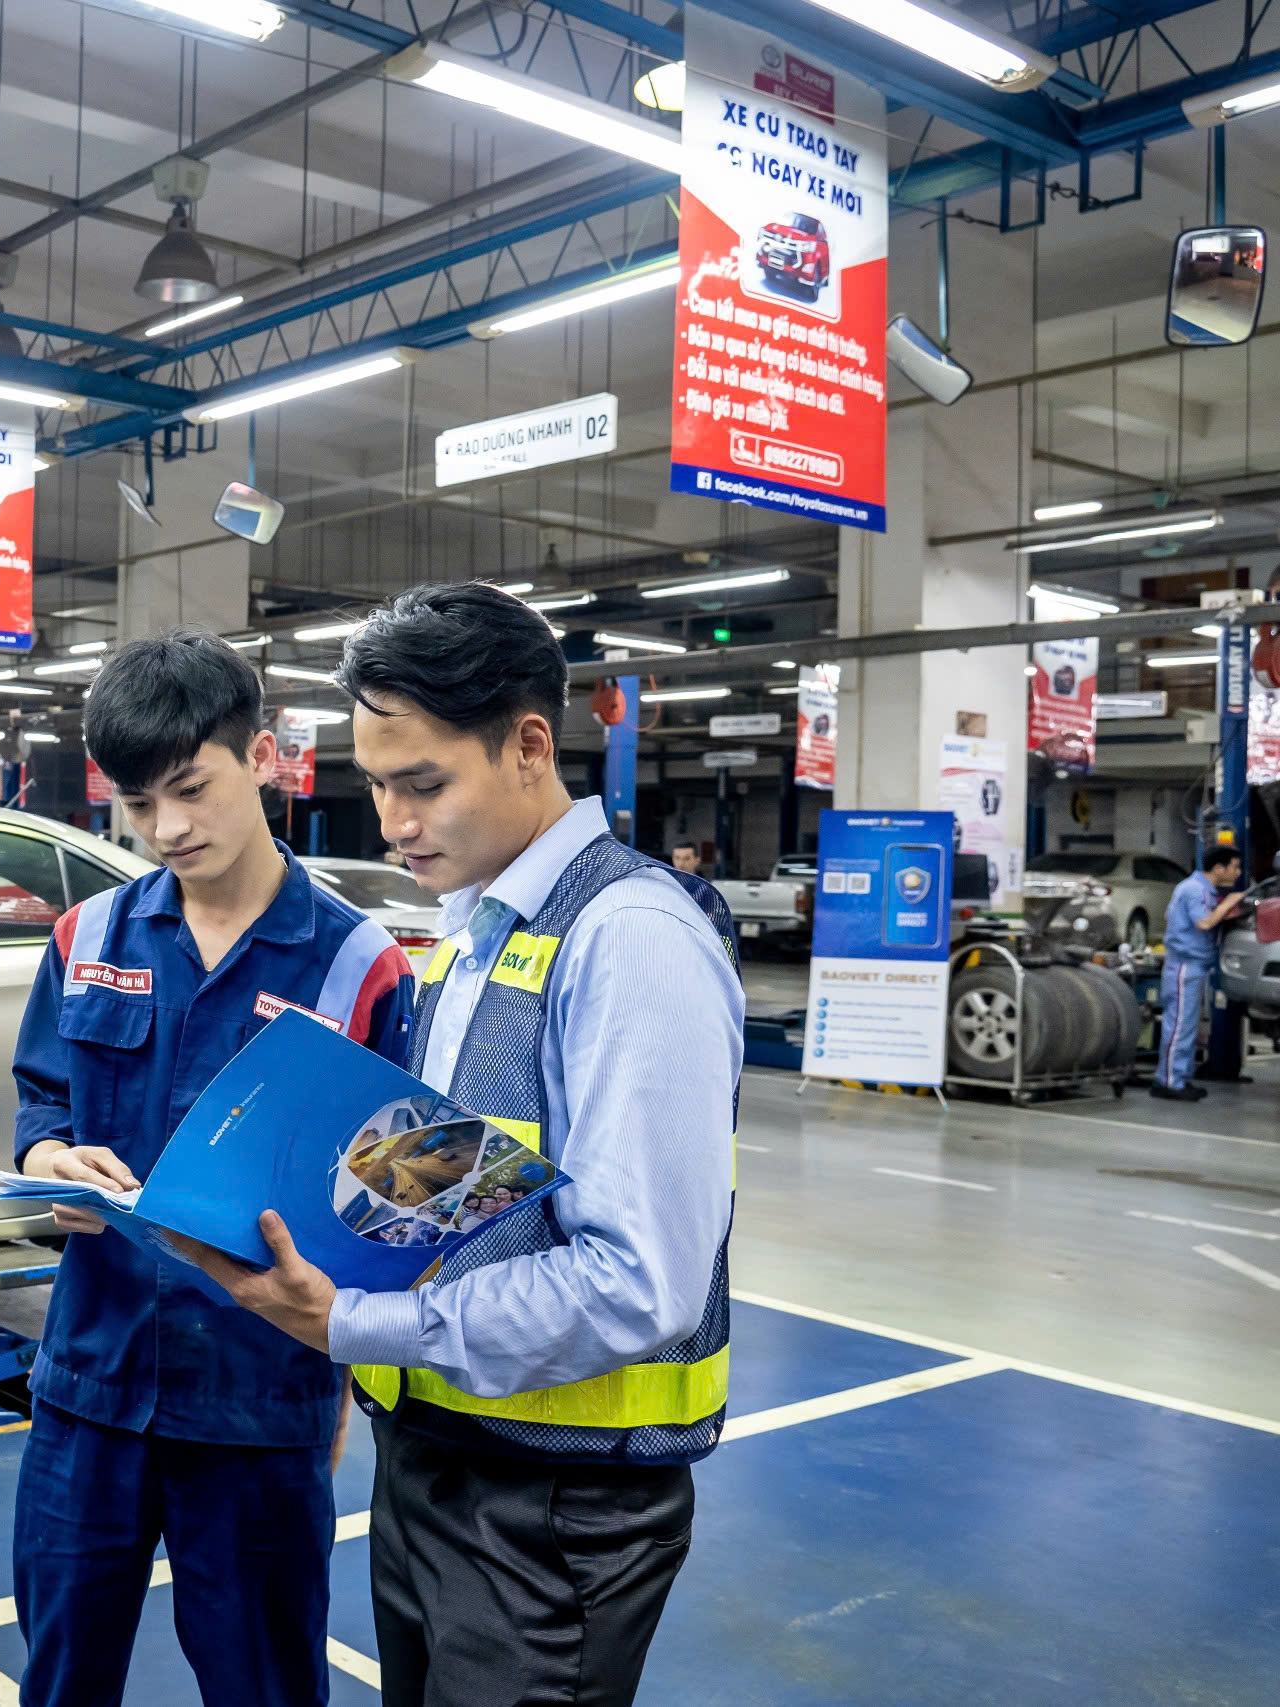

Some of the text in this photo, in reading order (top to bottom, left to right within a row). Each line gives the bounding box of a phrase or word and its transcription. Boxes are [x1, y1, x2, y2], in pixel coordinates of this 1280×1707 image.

[722, 99, 747, 127] XE
[786, 122, 828, 159] TRAO
[833, 144, 860, 174] TAY
[751, 152, 803, 188] NGAY
[807, 173, 826, 200] XE
[527, 417, 573, 443] NHANH
[586, 414, 608, 440] 02
[116, 974, 133, 988] VĂN
[134, 974, 146, 989] HÀ
[821, 970, 939, 985] BAOVIET DIRECT
[258, 999, 284, 1015] TOYO
[208, 1115, 233, 1147] BAOVIET
